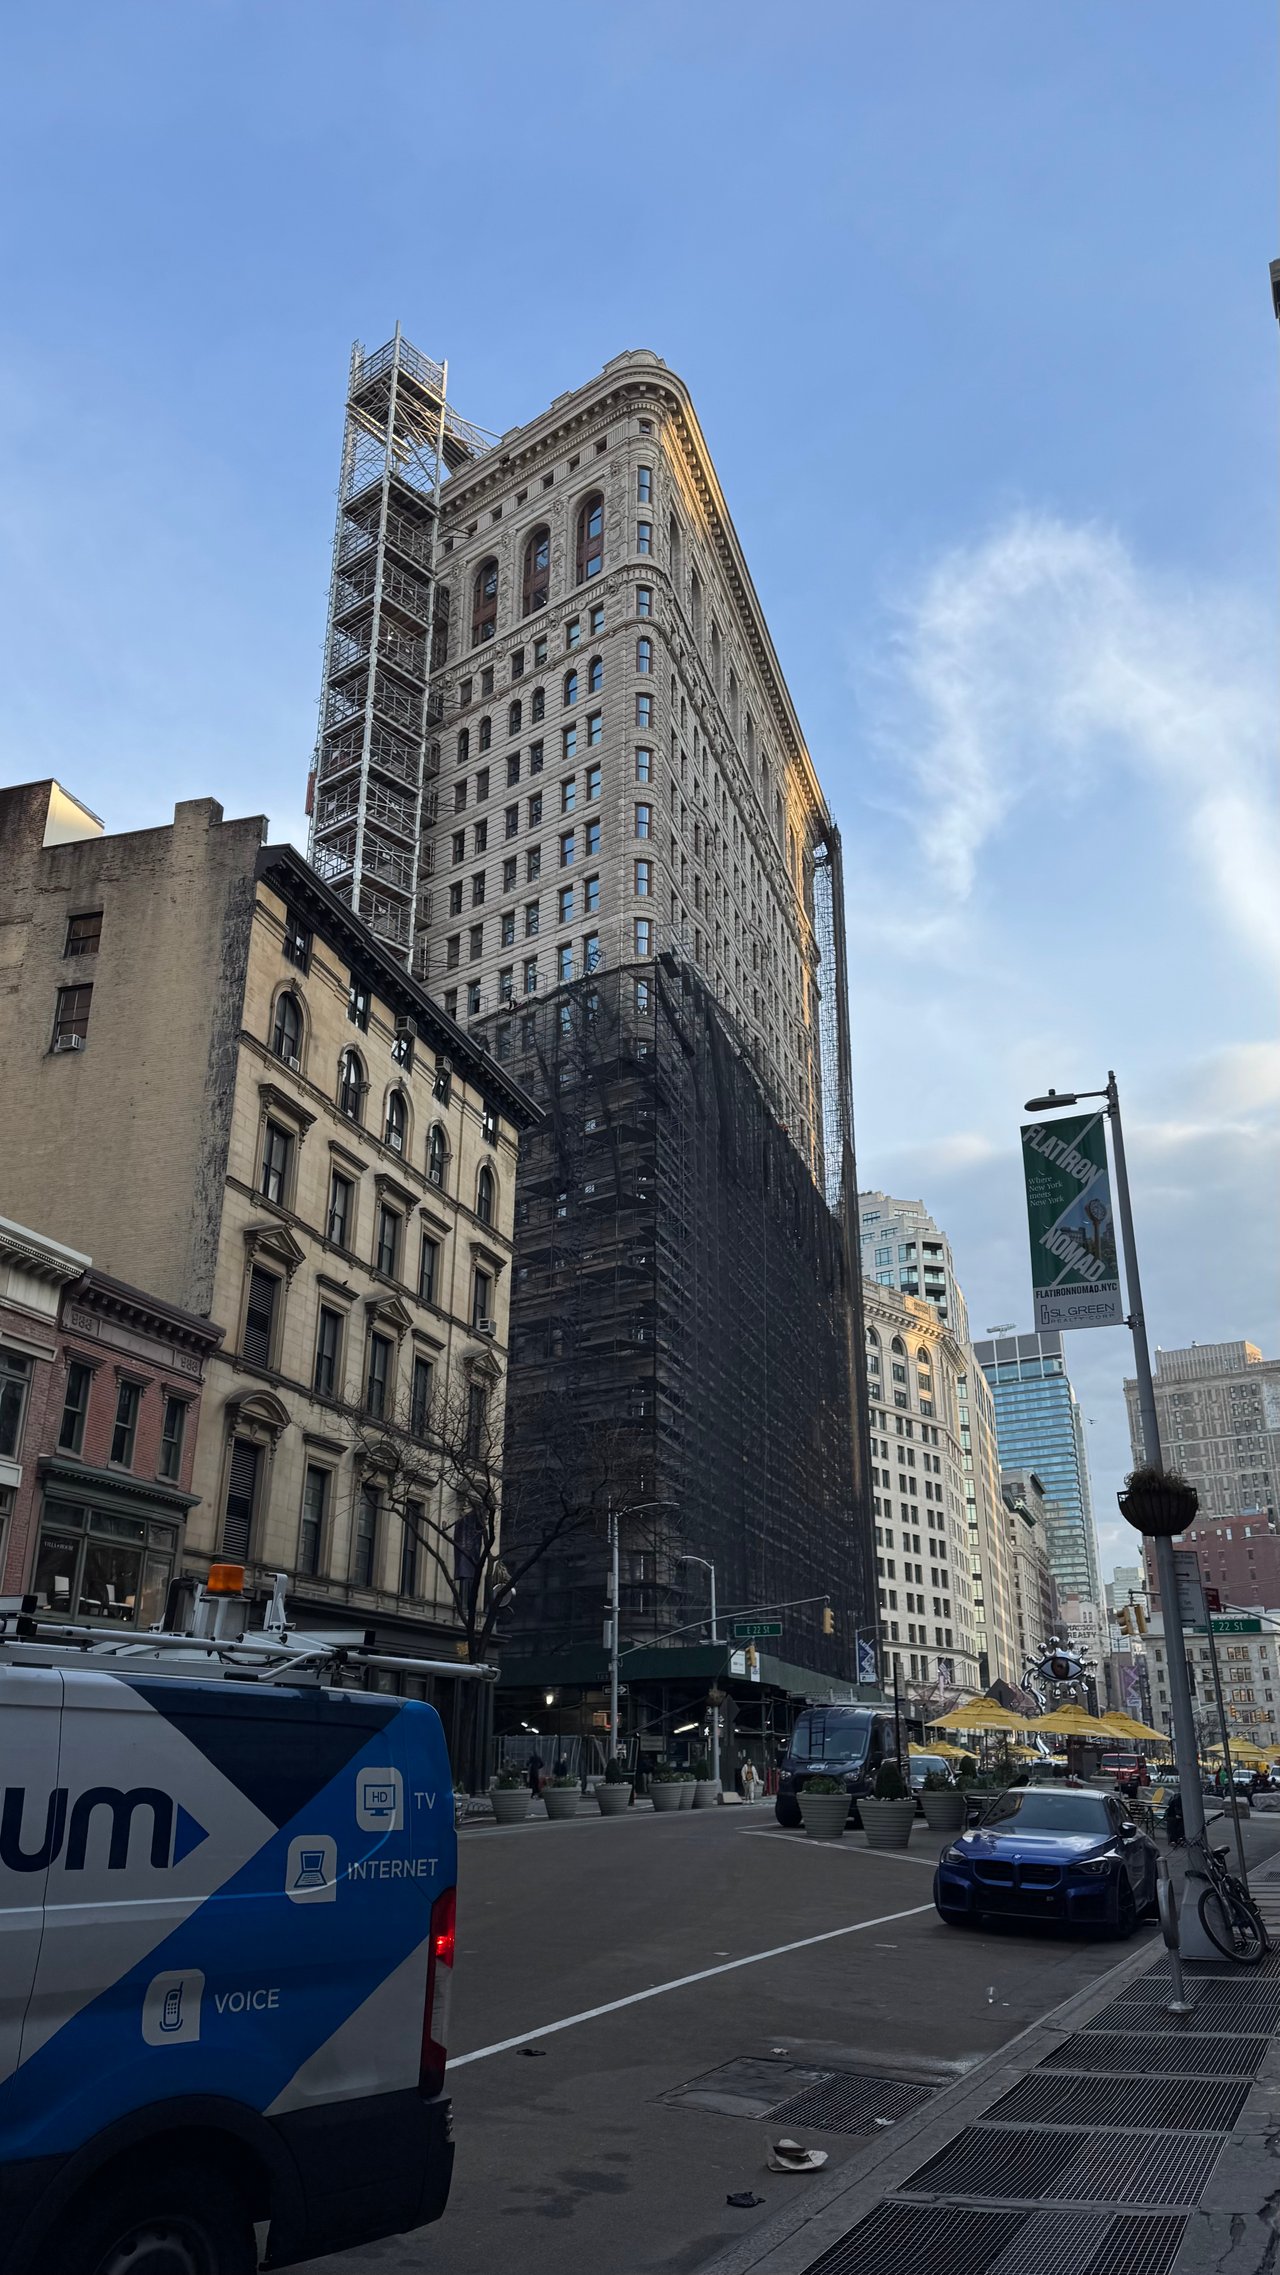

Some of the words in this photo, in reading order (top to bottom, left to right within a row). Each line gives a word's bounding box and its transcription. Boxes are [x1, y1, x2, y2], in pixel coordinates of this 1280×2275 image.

[1022, 1124, 1105, 1184] FLATIRON
[1028, 1176, 1053, 1184] Where
[1047, 1180, 1063, 1189] York
[1029, 1191, 1052, 1199] meets
[1030, 1199, 1047, 1207] New
[1047, 1195, 1065, 1204] York
[1038, 1228, 1106, 1282] NOMAD
[1035, 1282, 1118, 1299] FLATIRONNOMAD.NYC
[1050, 1308, 1065, 1318] SL
[1068, 1303, 1115, 1316] GREEN
[746, 1626, 751, 1634] E
[752, 1625, 761, 1634] 22
[763, 1625, 770, 1634] St
[1218, 1621, 1230, 1631] 22
[1233, 1621, 1244, 1631] St
[371, 1791, 388, 1804] HD
[414, 1792, 437, 1810] TV
[347, 1858, 439, 1880] INTERNET
[214, 1988, 281, 2014] VOICE
